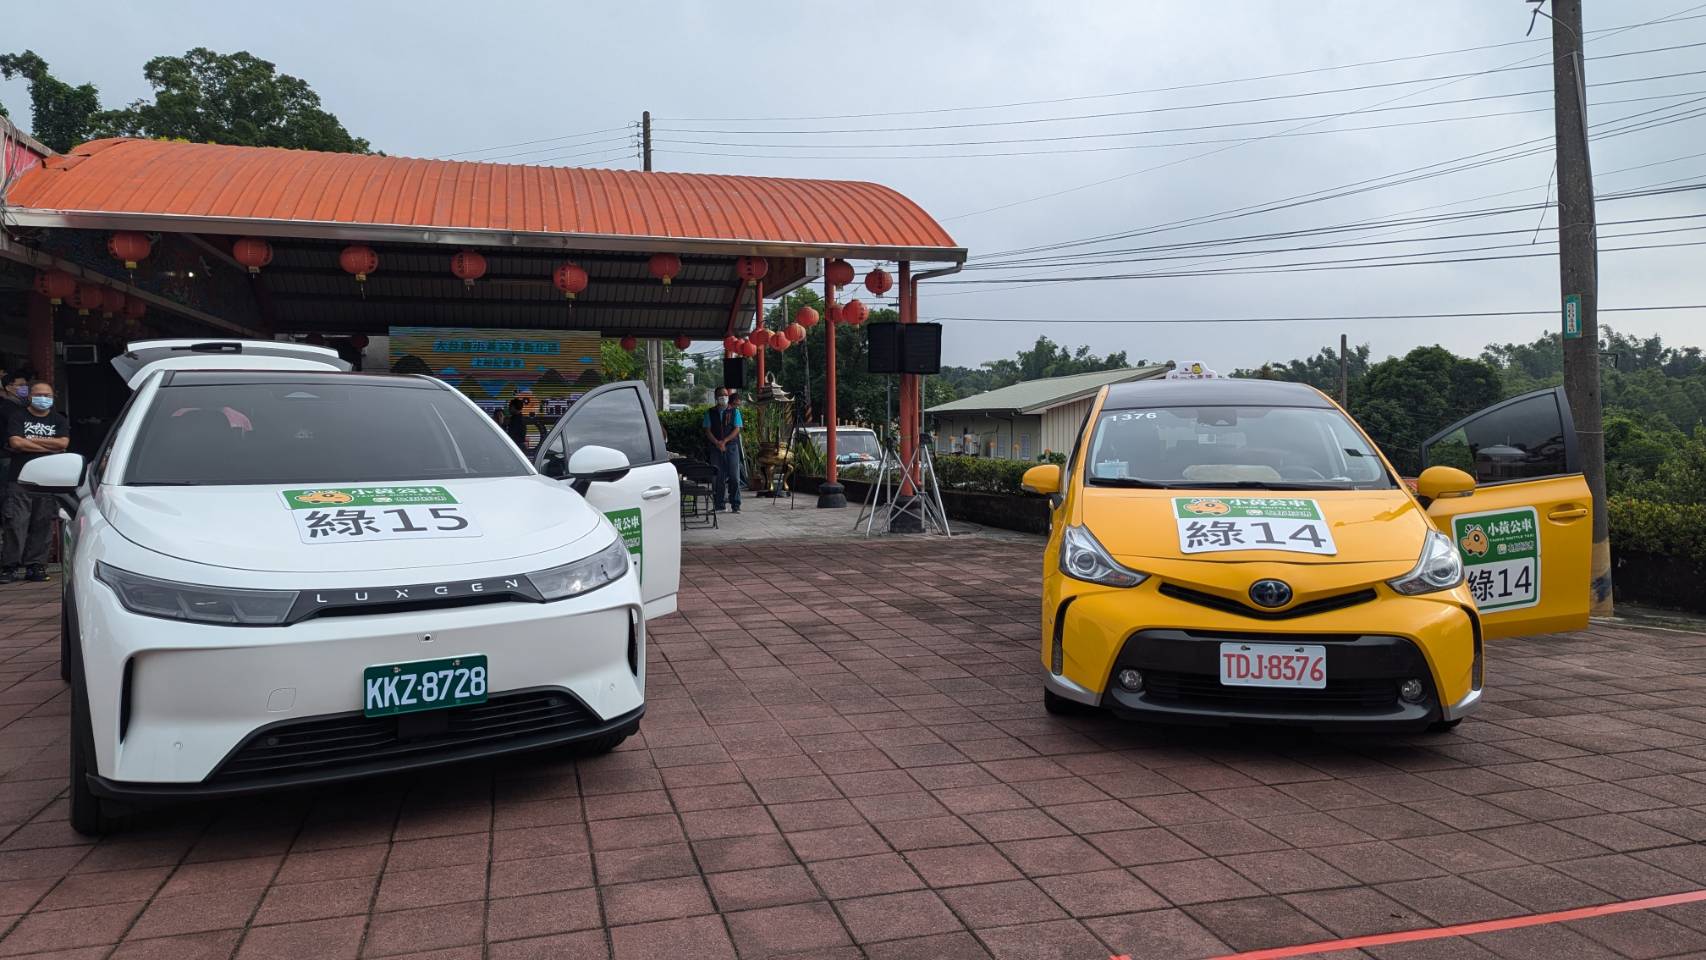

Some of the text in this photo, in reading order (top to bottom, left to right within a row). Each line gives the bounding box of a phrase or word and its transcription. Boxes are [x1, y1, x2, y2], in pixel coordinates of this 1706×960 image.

[1112, 412, 1157, 422] 1376
[305, 507, 469, 538] 綠15
[1186, 520, 1327, 549] 綠14
[1488, 518, 1532, 536] 小黃公車
[316, 579, 519, 603] LUXGEN
[1468, 565, 1532, 602] 綠14
